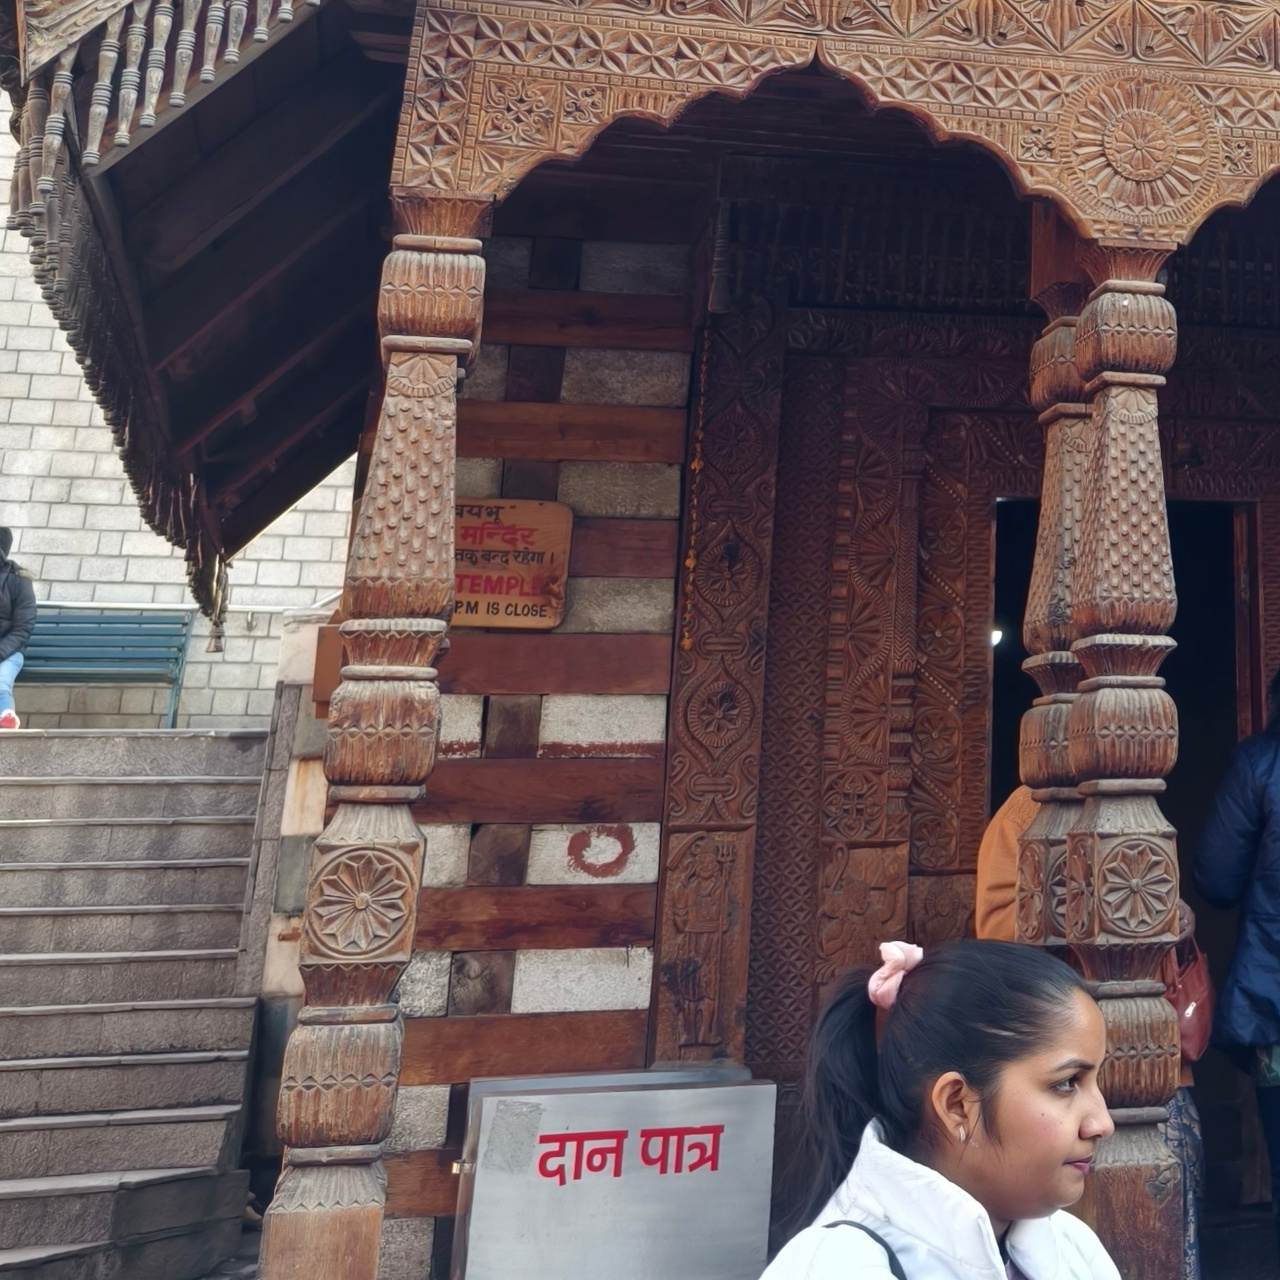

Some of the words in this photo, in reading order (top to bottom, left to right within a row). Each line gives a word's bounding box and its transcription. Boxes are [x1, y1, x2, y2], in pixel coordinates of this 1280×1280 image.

[486, 602, 500, 615] IS
[536, 1129, 629, 1186] दान
[640, 1124, 725, 1175] पात्र
